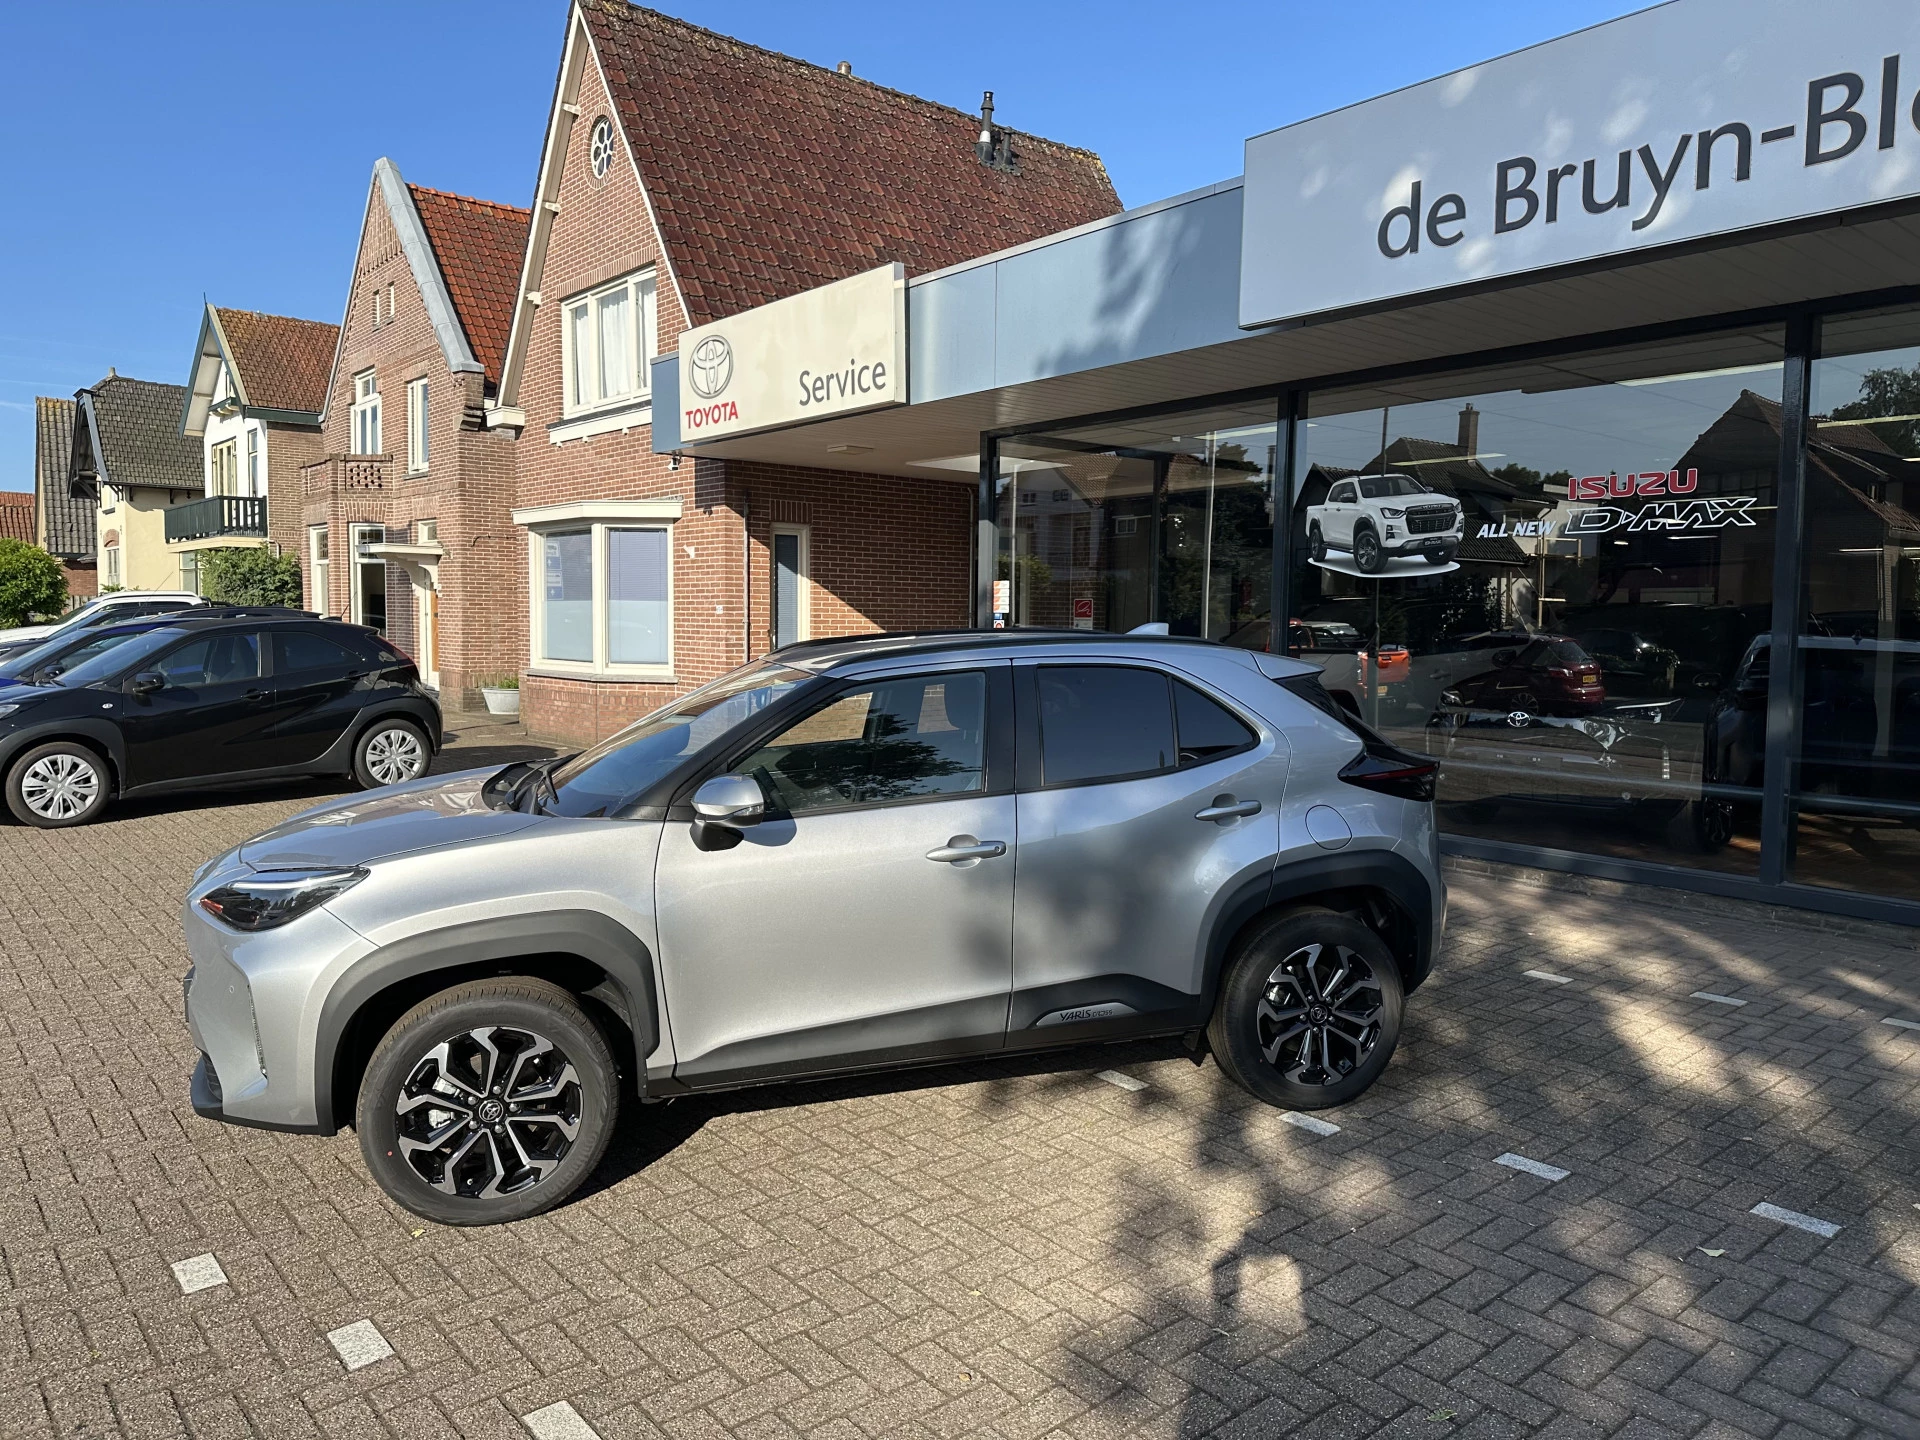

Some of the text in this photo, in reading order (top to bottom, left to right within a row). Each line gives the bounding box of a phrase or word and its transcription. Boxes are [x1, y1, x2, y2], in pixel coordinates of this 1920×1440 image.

[1377, 54, 1920, 259] de Bruyn-Bl
[799, 358, 886, 406] Service
[685, 401, 738, 429] TOYOTA
[1568, 468, 1697, 500] ISUZU
[1476, 523, 1508, 539] ALL
[1513, 520, 1557, 537] NEW
